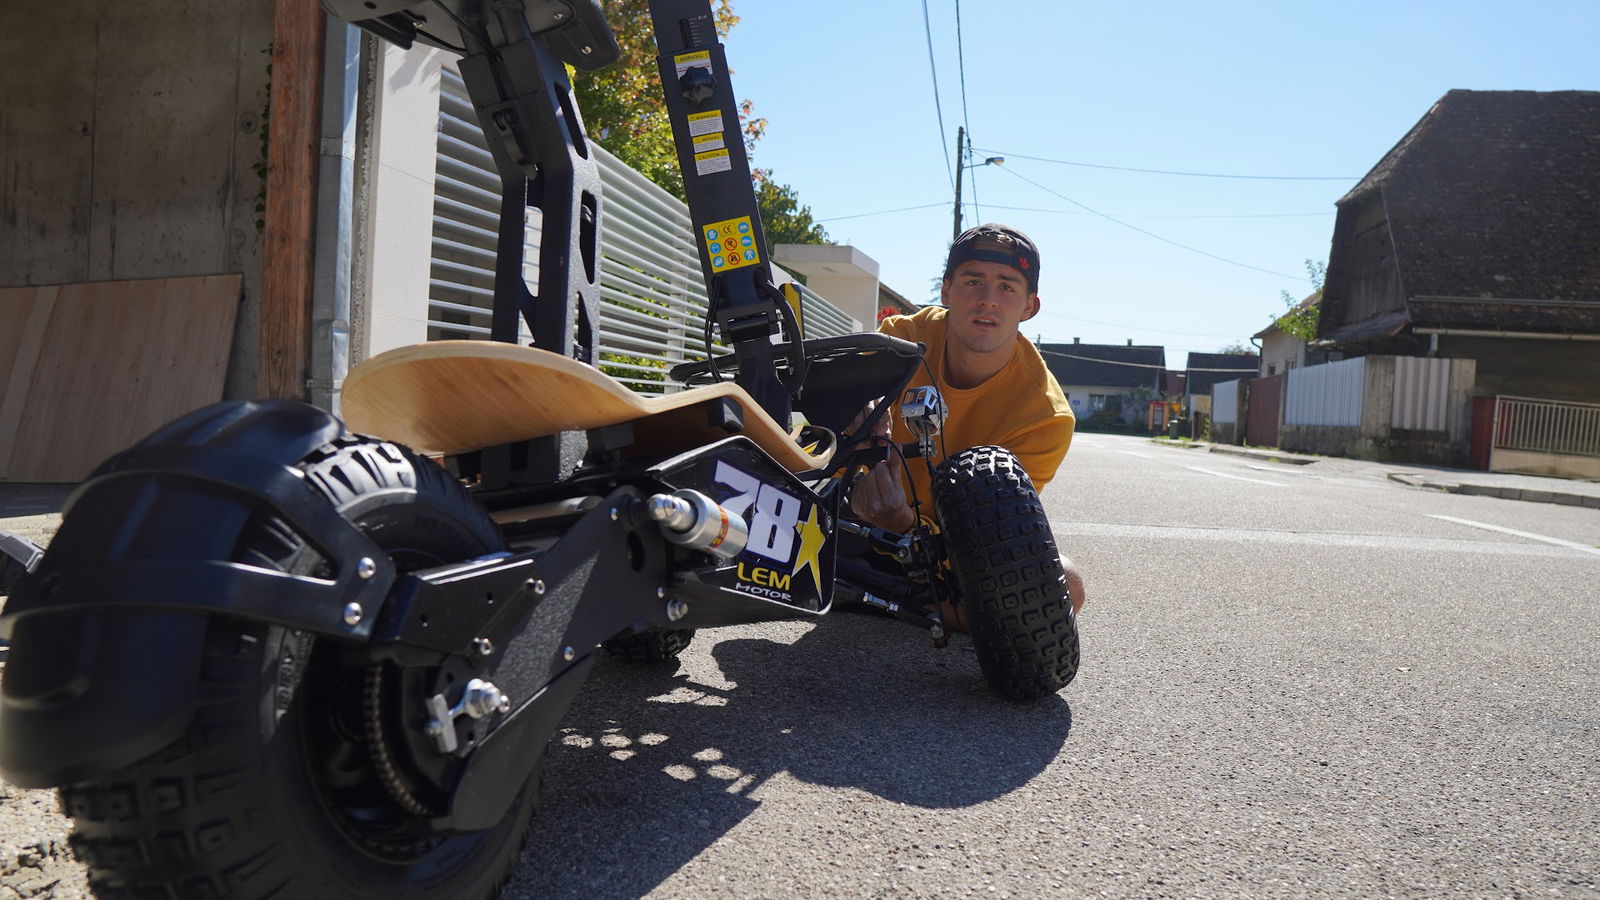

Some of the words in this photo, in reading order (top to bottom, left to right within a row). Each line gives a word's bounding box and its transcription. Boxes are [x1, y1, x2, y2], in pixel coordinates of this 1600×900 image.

[714, 459, 801, 564] 78
[737, 561, 792, 591] LEM
[735, 582, 792, 602] MOTOR
